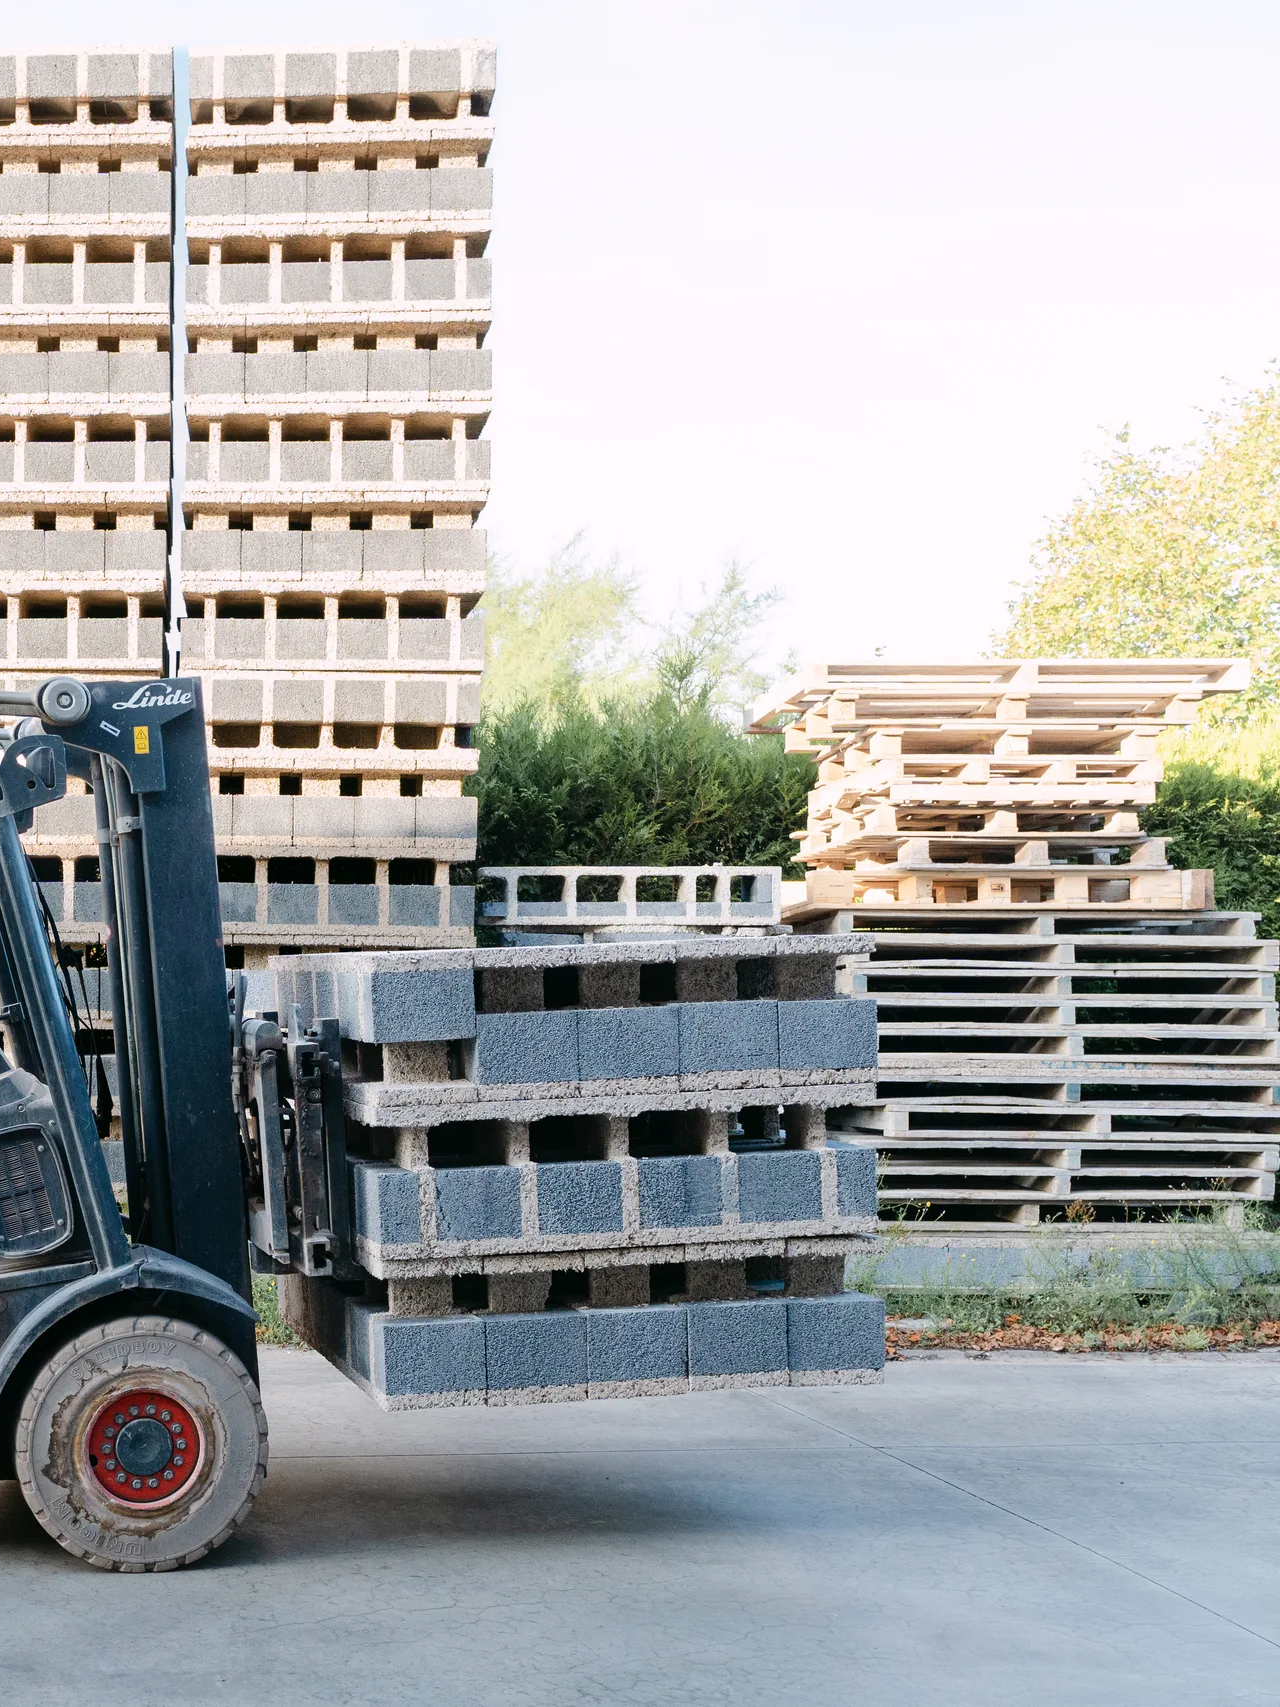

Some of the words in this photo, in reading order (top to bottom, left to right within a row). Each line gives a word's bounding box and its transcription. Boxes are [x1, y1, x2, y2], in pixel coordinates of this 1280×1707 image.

[112, 682, 192, 710] Linde
[71, 1340, 177, 1381] SOLIDBOY
[50, 1495, 143, 1556] UNIGOM
